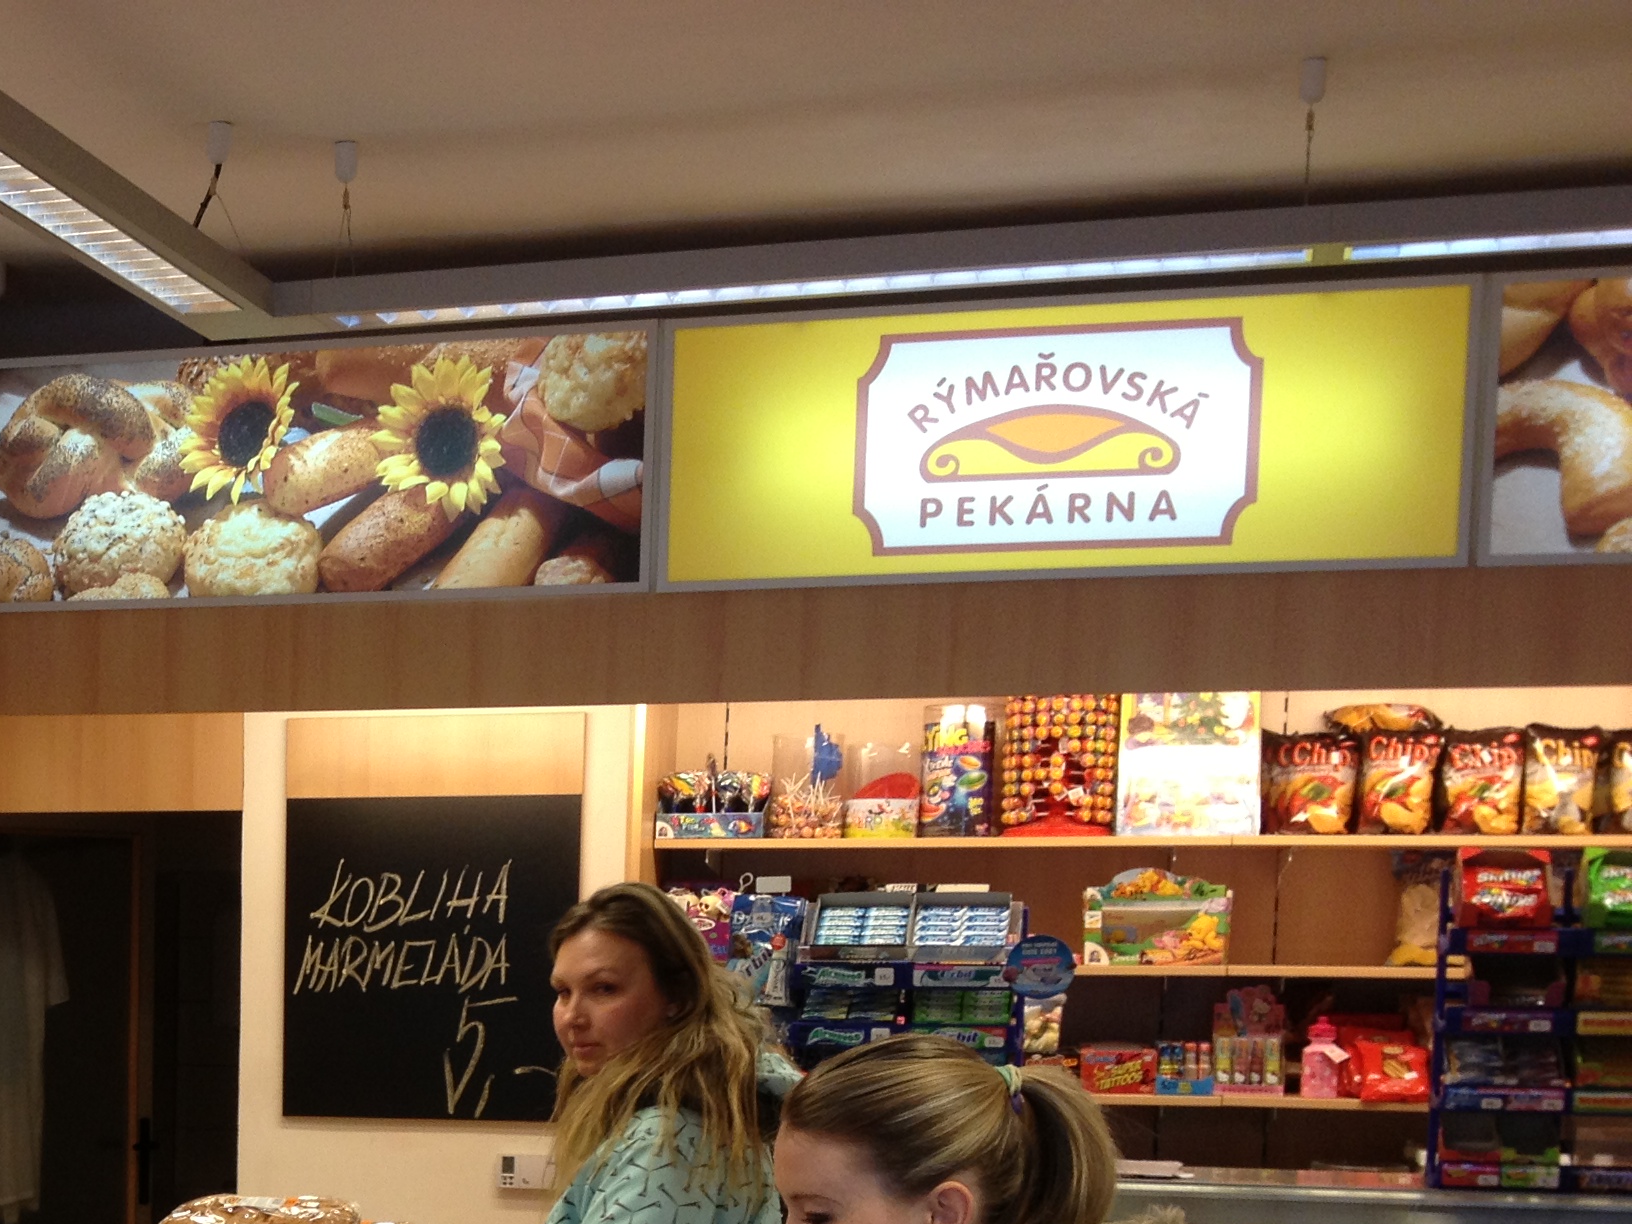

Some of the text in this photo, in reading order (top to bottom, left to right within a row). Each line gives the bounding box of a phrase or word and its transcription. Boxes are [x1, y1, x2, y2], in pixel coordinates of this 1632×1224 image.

[907, 351, 1210, 434] RÝMAŘOVSKÁ
[919, 484, 1179, 528] PEKÁRNA
[310, 858, 512, 932] KOBLIHA
